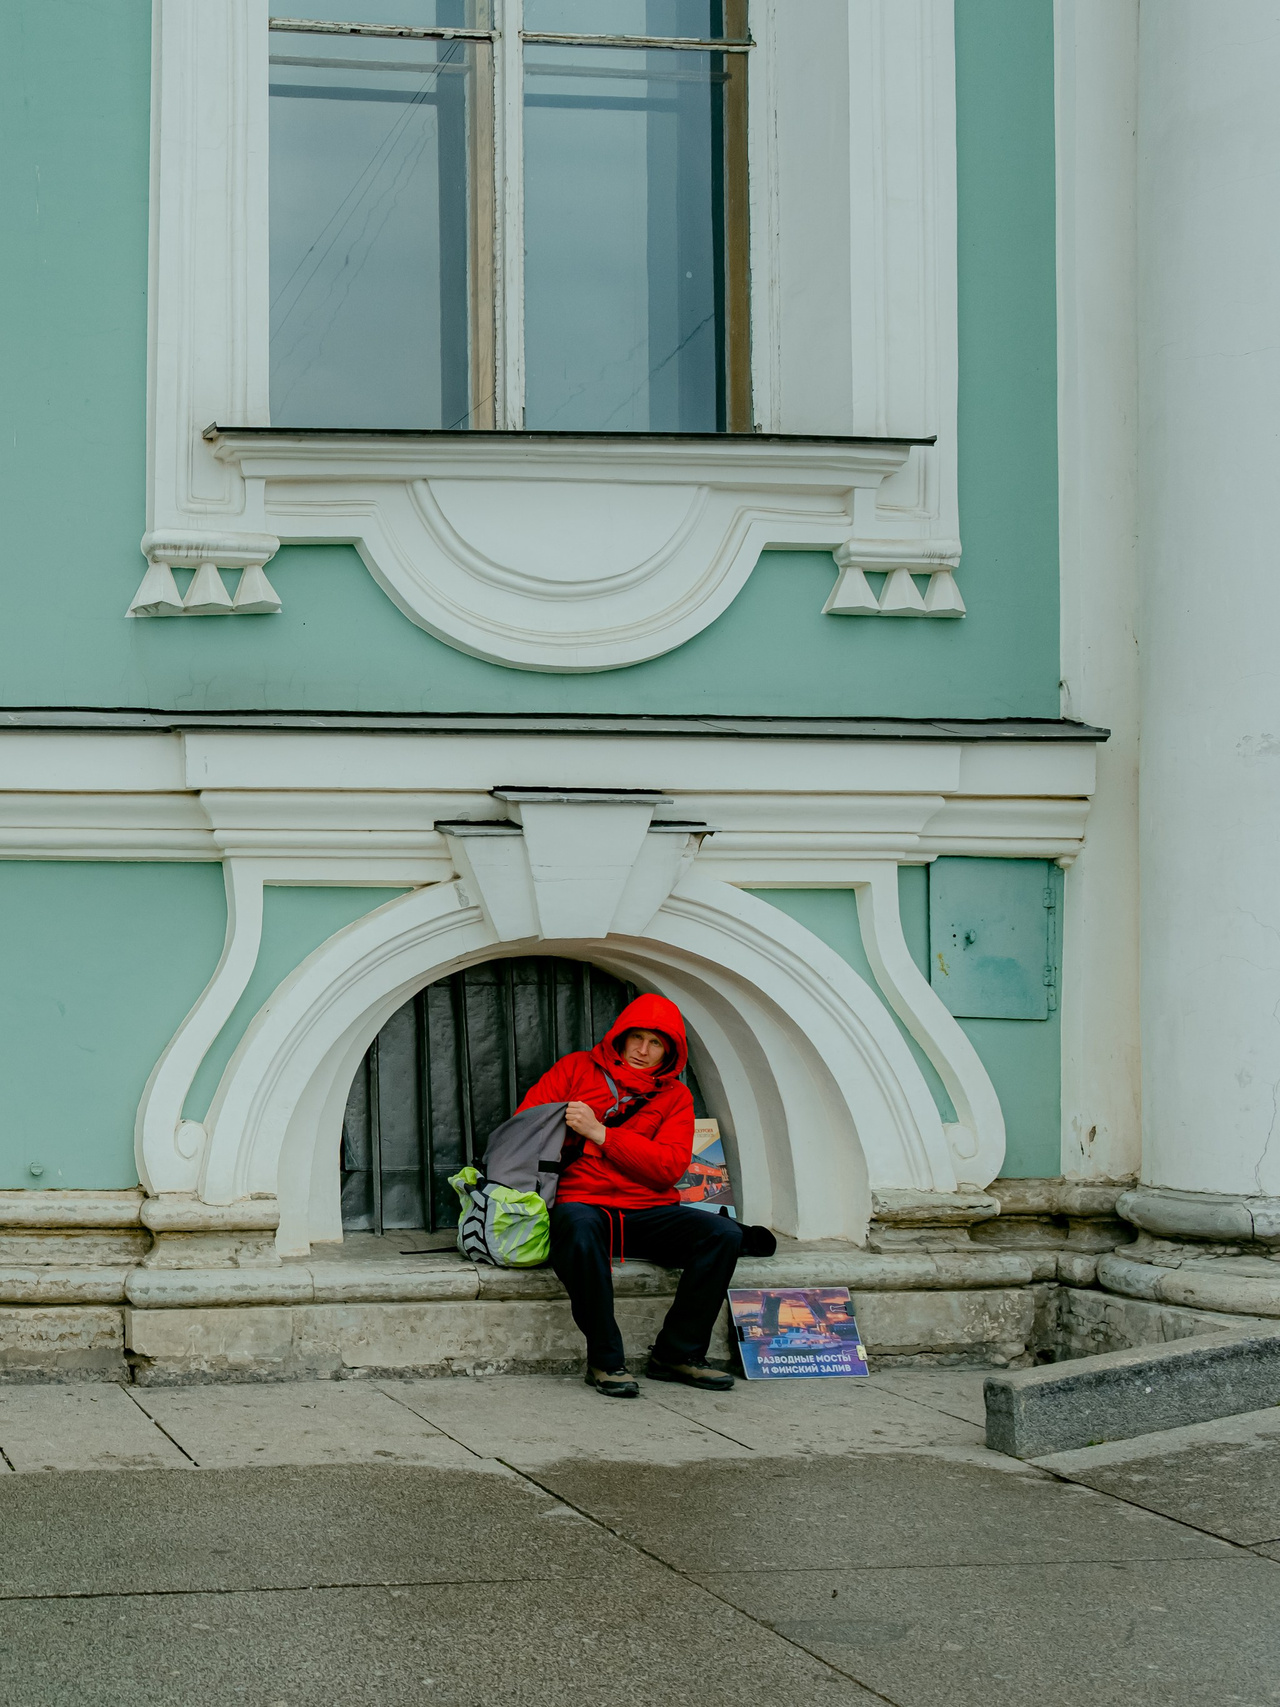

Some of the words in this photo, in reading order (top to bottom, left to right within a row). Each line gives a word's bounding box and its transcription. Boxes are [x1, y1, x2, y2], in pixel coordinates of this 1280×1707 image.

[757, 1355, 815, 1364] РАЗВОДНЫЕ
[816, 1354, 851, 1362] МОСТЫ
[762, 1366, 769, 1374] И
[771, 1364, 819, 1374] ФИНСКИЙ
[820, 1364, 851, 1372] ЗАЛИВ
